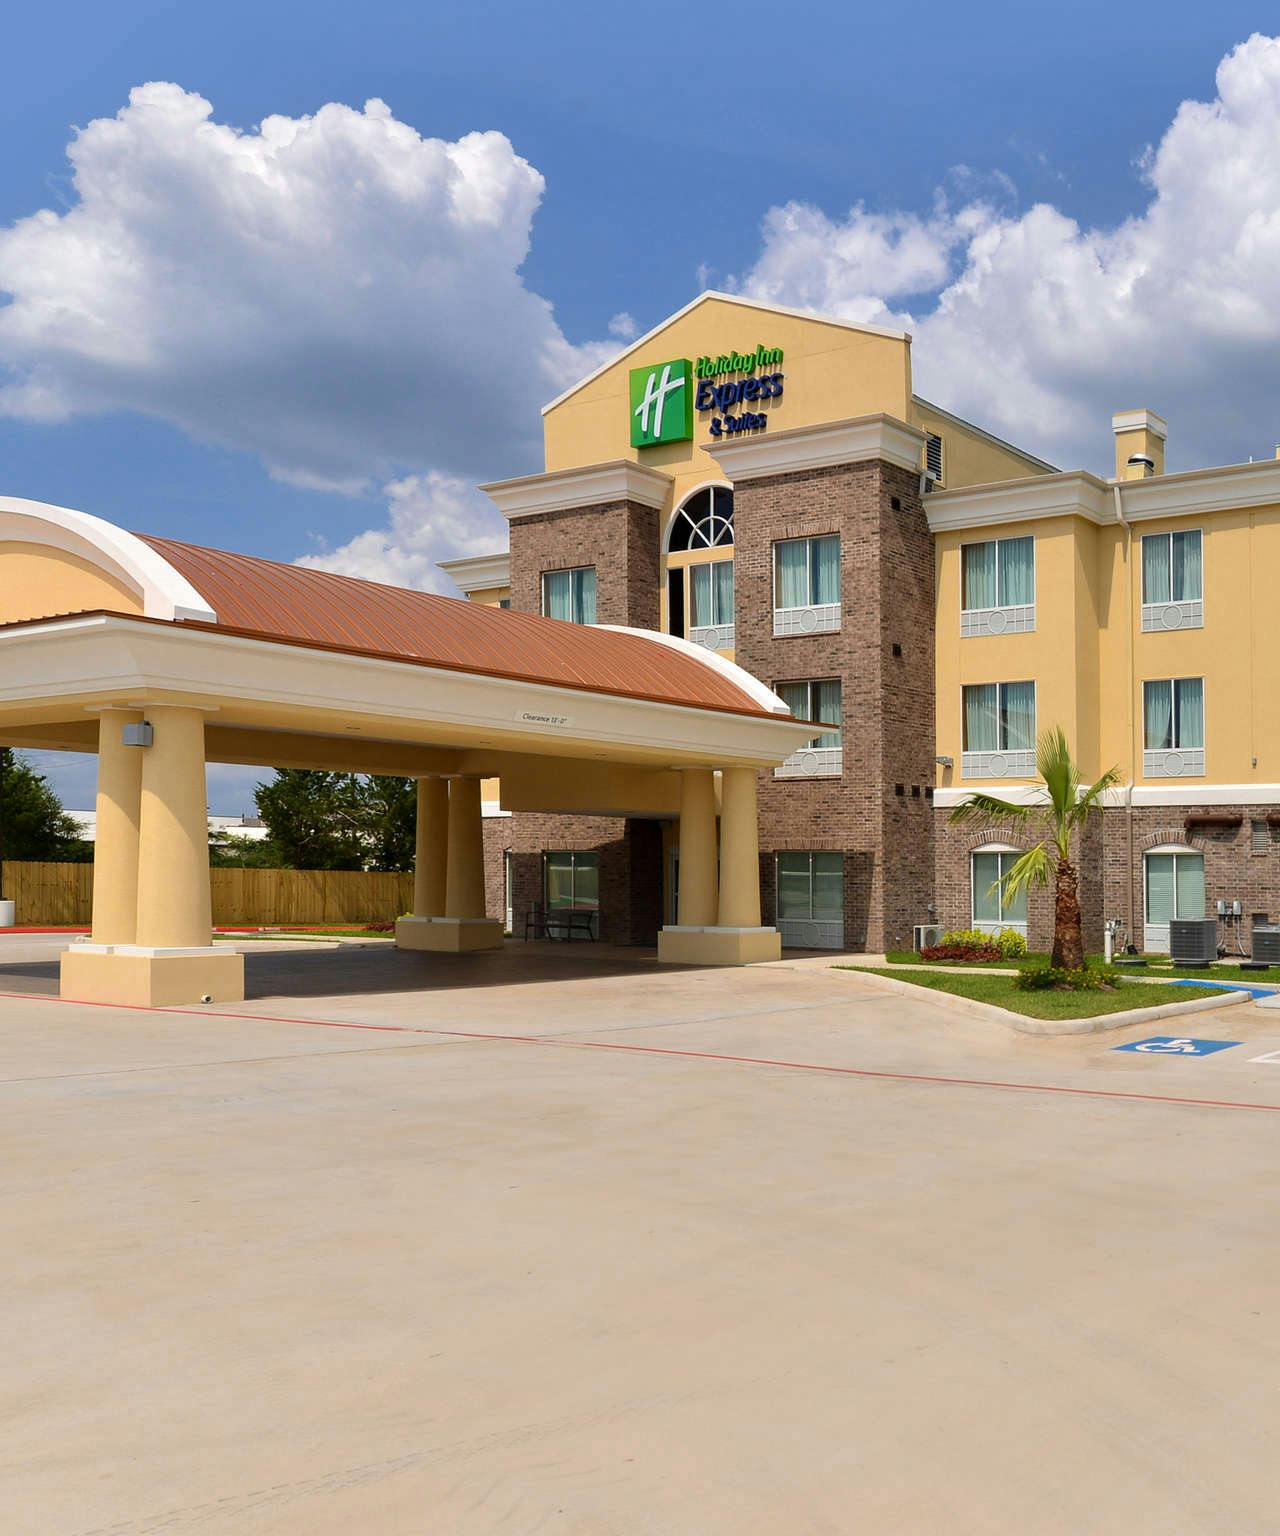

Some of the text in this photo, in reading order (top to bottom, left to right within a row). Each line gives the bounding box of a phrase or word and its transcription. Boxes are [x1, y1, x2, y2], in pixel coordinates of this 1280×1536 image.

[695, 344, 784, 377] Holiday Inn
[695, 372, 785, 413] Express
[709, 411, 768, 436] & Suites
